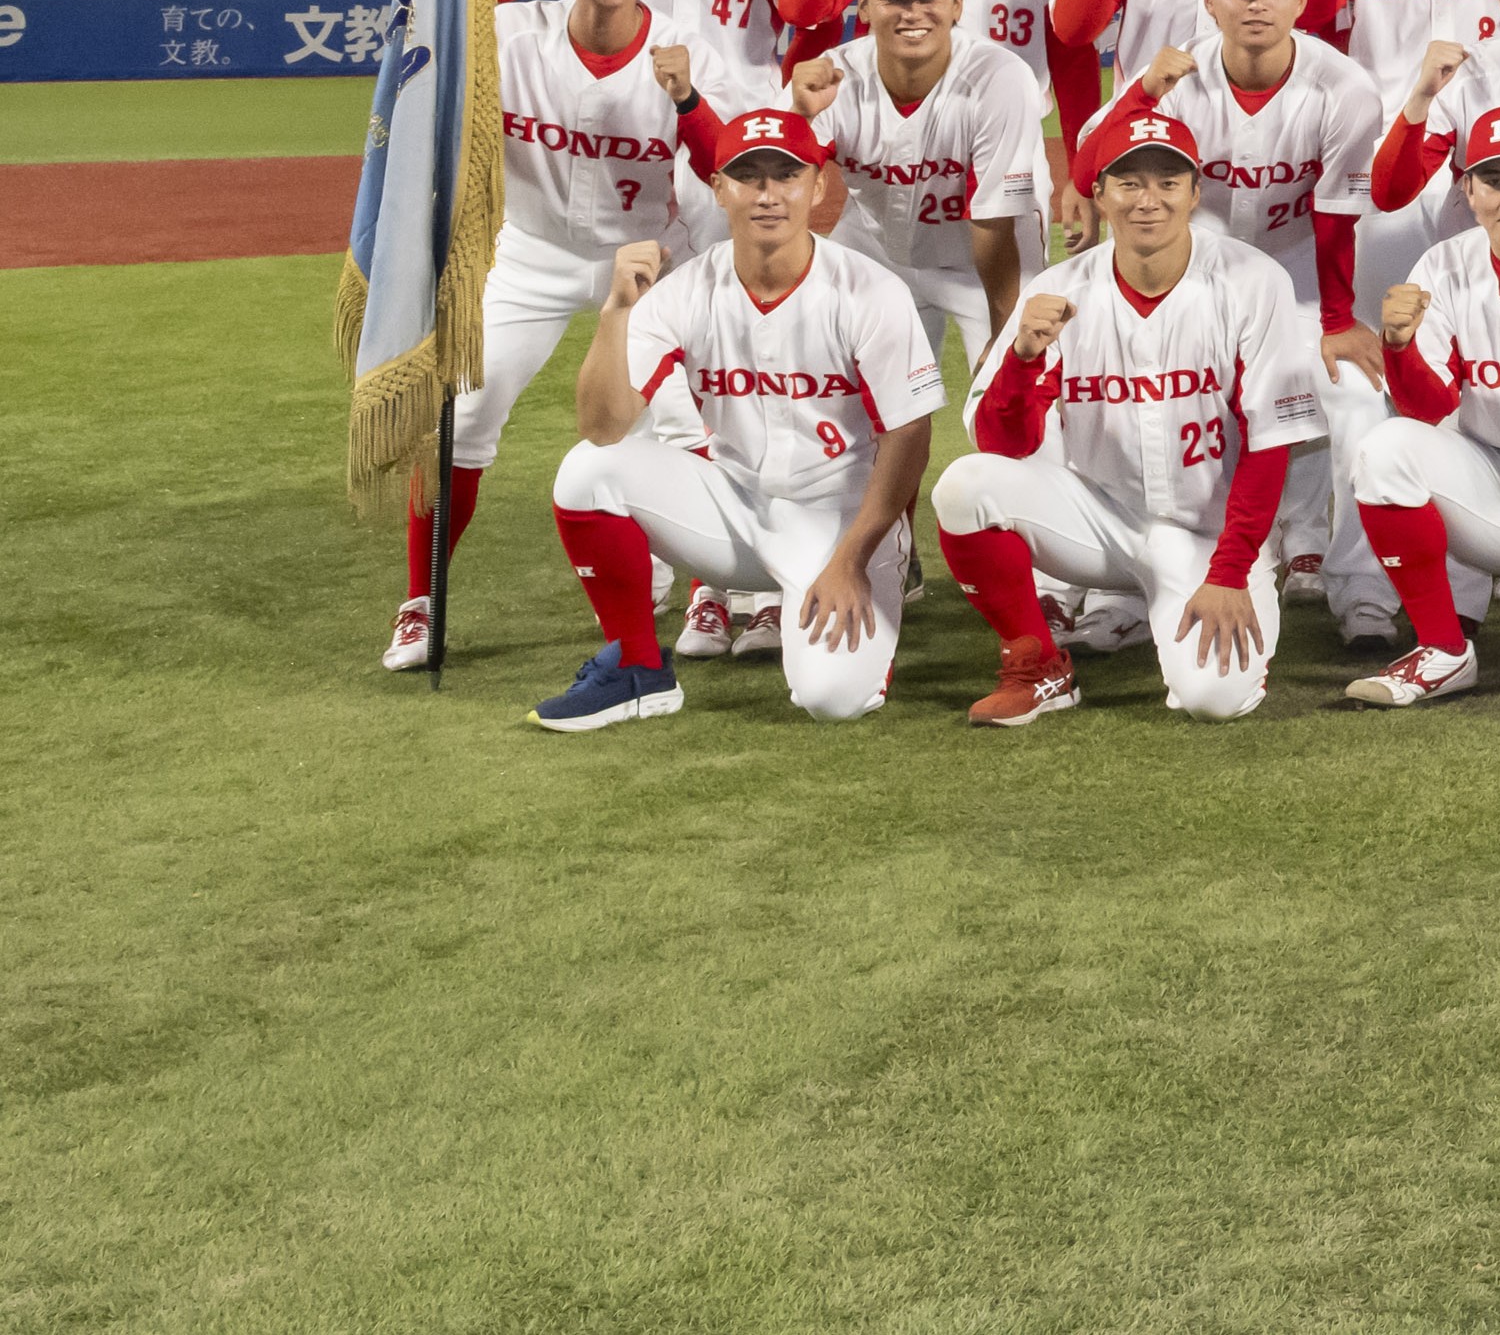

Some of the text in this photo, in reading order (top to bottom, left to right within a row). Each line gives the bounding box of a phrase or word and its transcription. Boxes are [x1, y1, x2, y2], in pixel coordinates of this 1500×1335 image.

[161, 5, 256, 32] 育ての、
[989, 3, 1035, 46] 33
[159, 41, 232, 66] 文教。
[502, 111, 676, 163] HONDA
[742, 117, 784, 141] H
[1129, 115, 1173, 144] H
[1203, 158, 1324, 189] ONDA
[919, 193, 964, 225] 29
[699, 368, 861, 400] HONDA
[1064, 367, 1222, 404] HONDA
[816, 420, 847, 460] 9
[1180, 416, 1227, 468] 23
